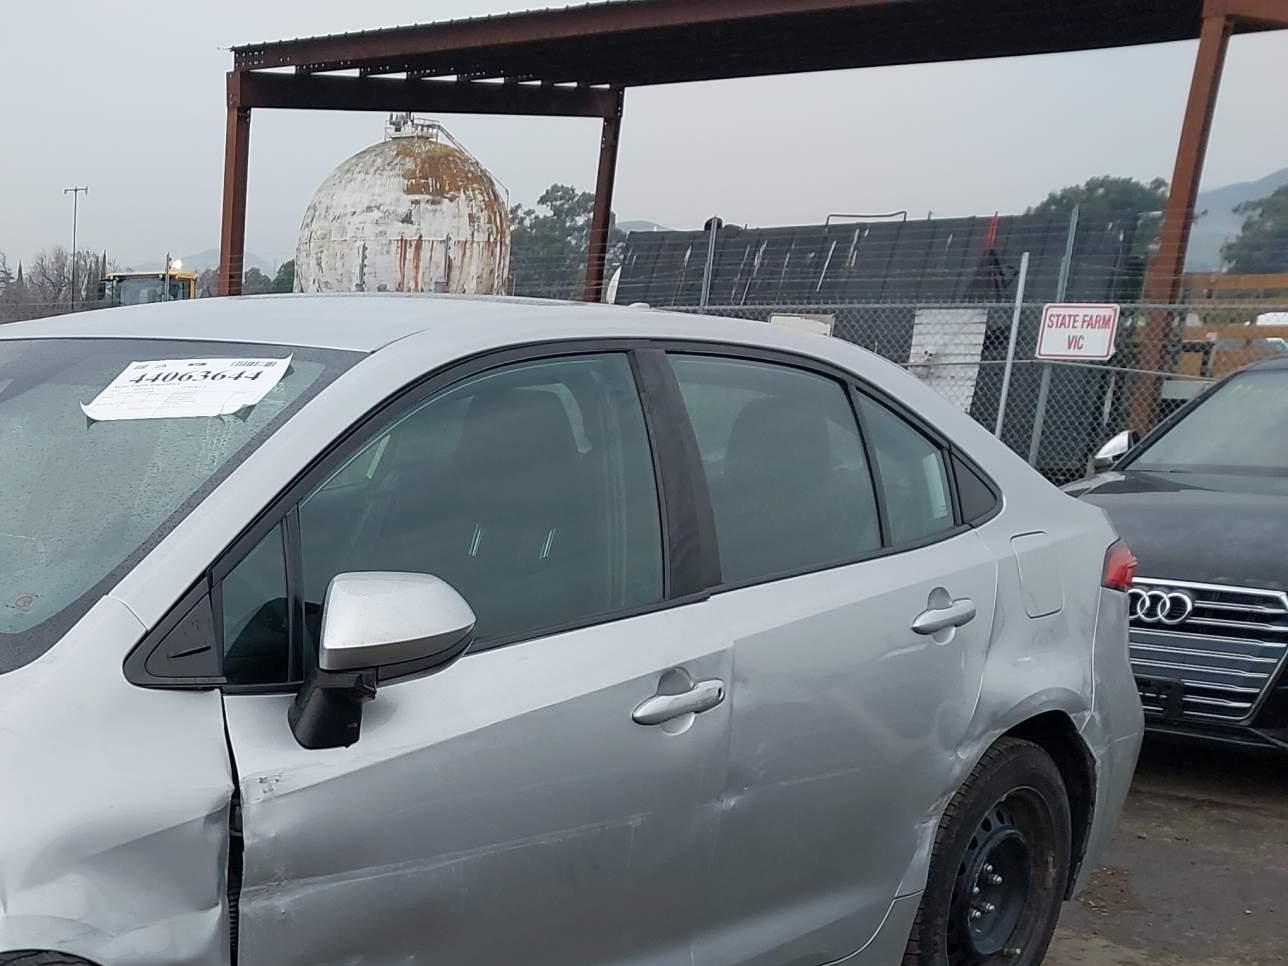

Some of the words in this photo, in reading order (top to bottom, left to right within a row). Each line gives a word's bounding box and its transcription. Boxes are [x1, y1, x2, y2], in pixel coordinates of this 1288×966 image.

[1047, 314, 1079, 329] STATE
[1082, 314, 1112, 329] FARM
[1067, 335, 1085, 350] VIC
[129, 370, 264, 383] 44063644
